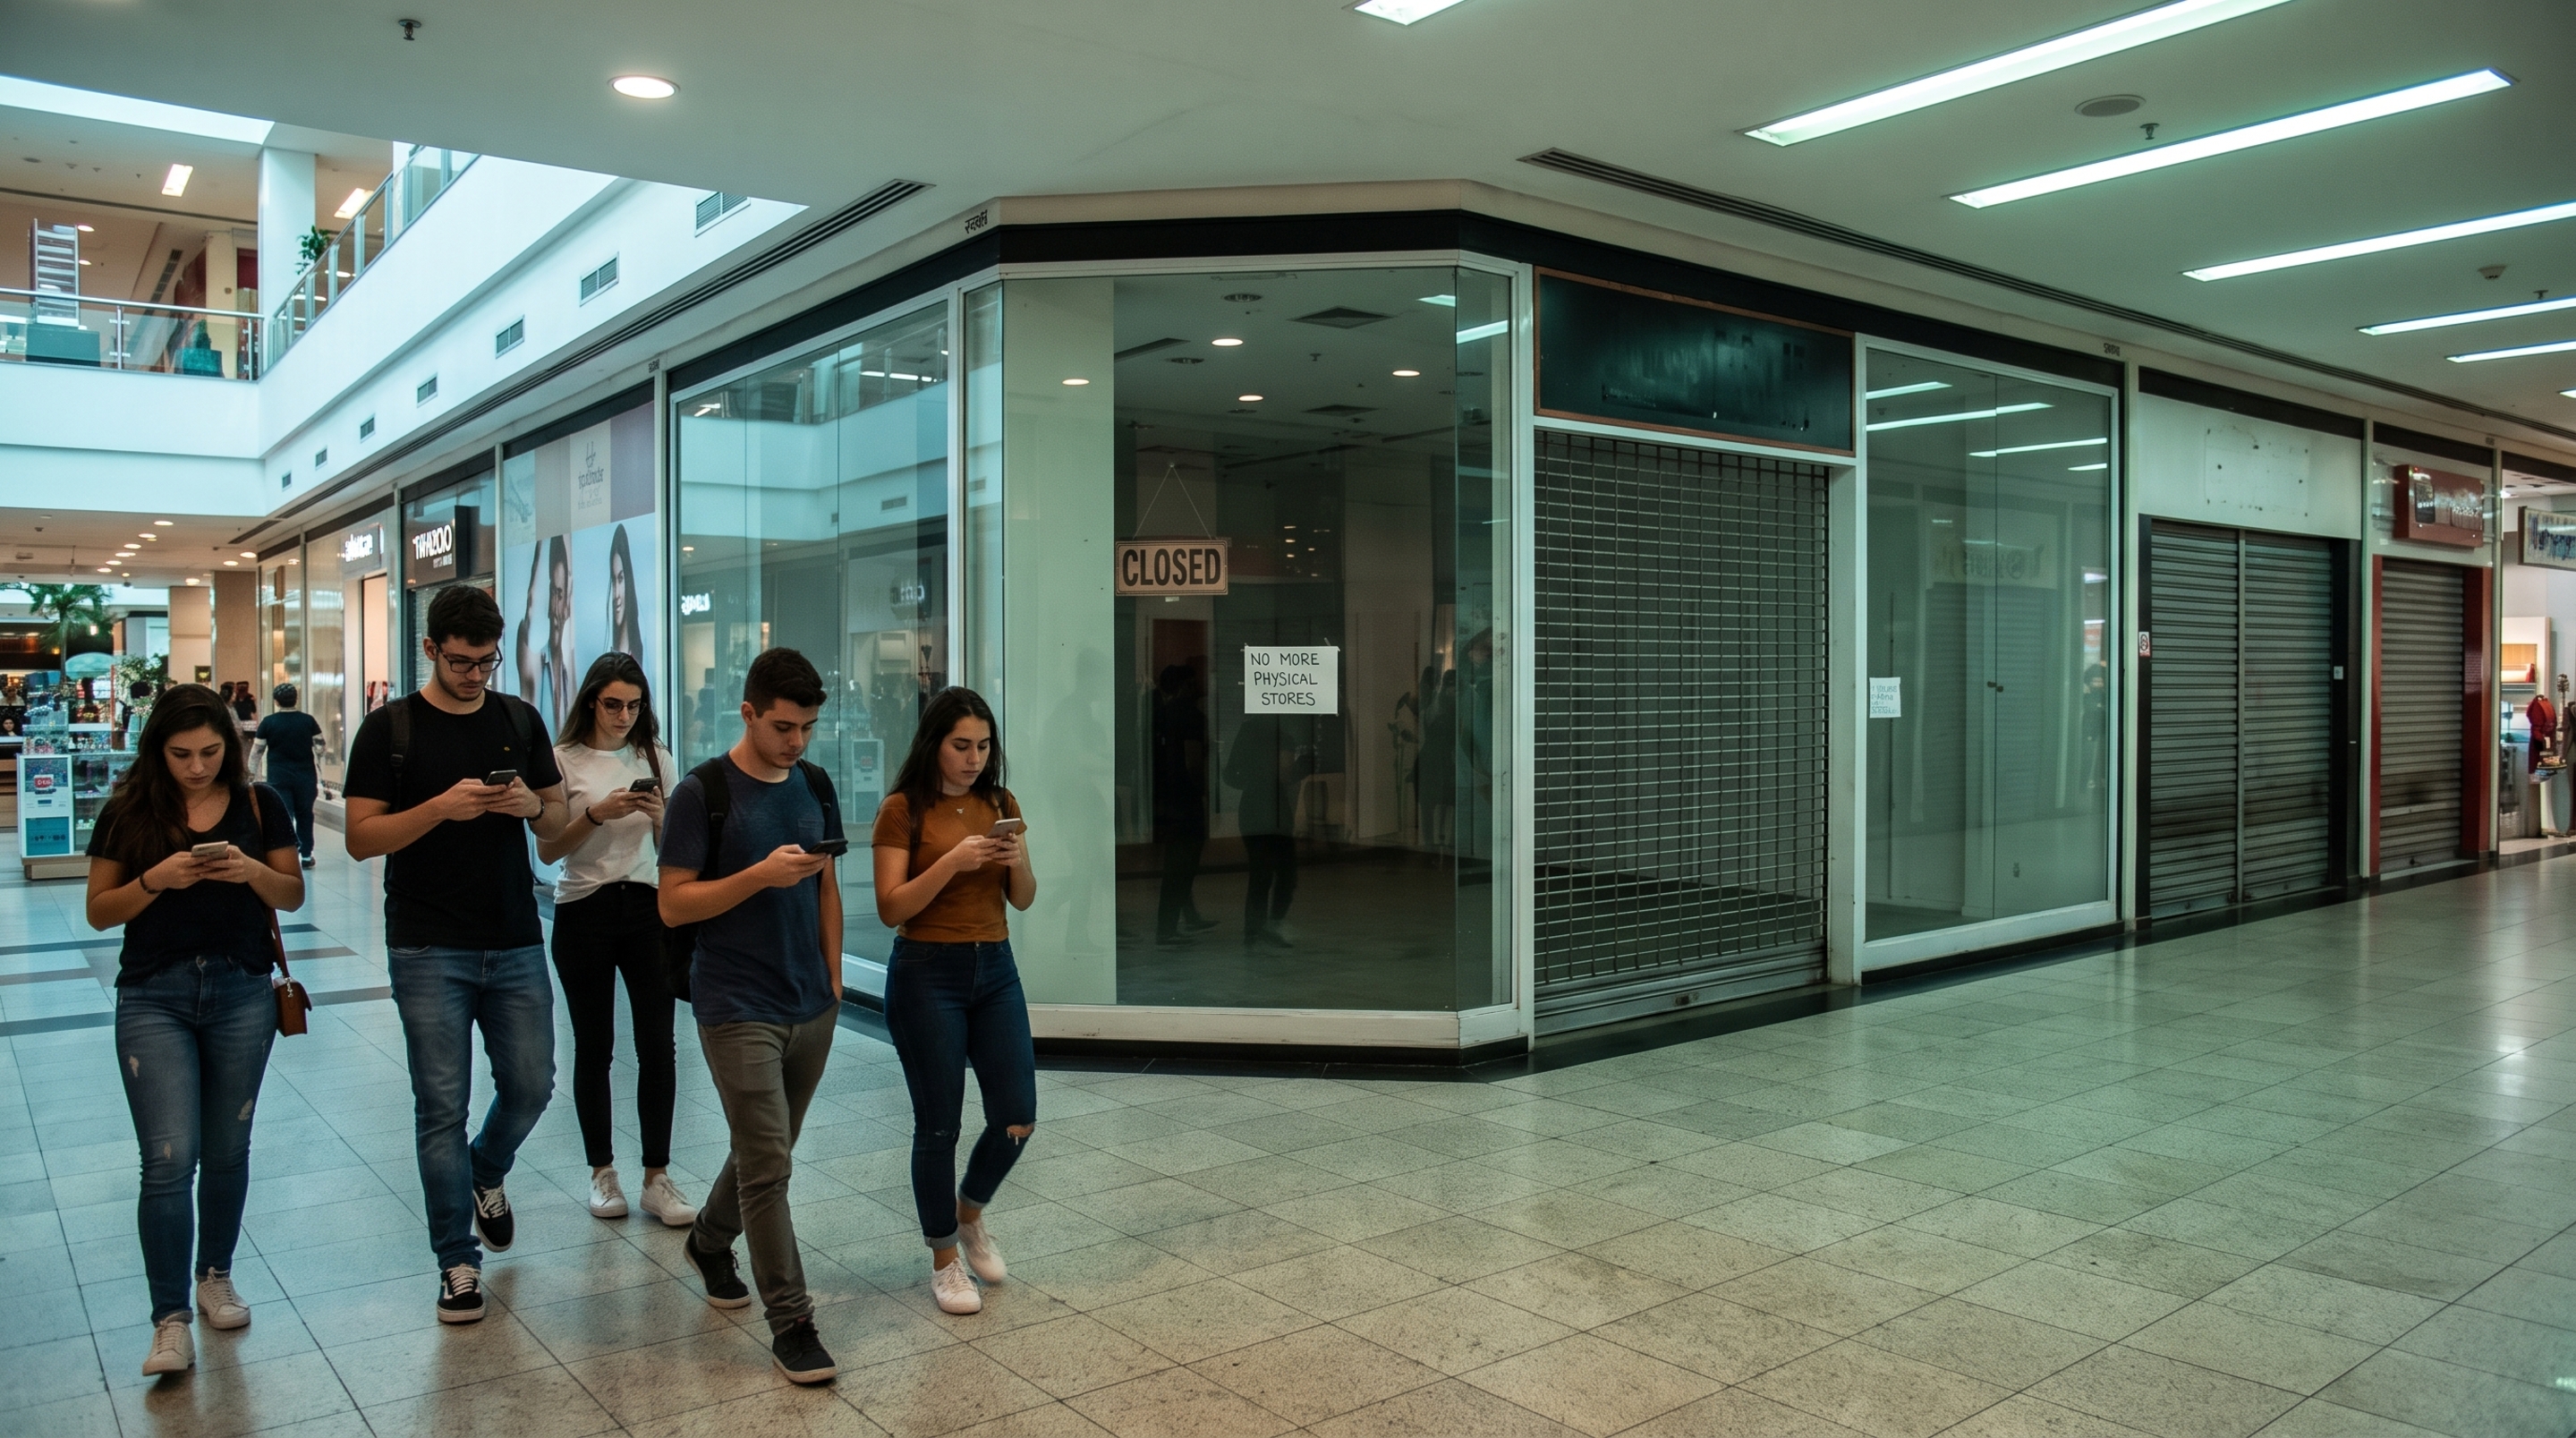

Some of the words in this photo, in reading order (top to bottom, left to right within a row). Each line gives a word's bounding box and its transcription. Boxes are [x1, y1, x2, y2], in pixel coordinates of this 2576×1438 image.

[1122, 549, 1221, 586] CLOSED
[1251, 652, 1271, 666] NO
[1279, 652, 1320, 666] MORE
[1254, 671, 1318, 687] PHYSICAL
[1261, 692, 1315, 706] STORES
